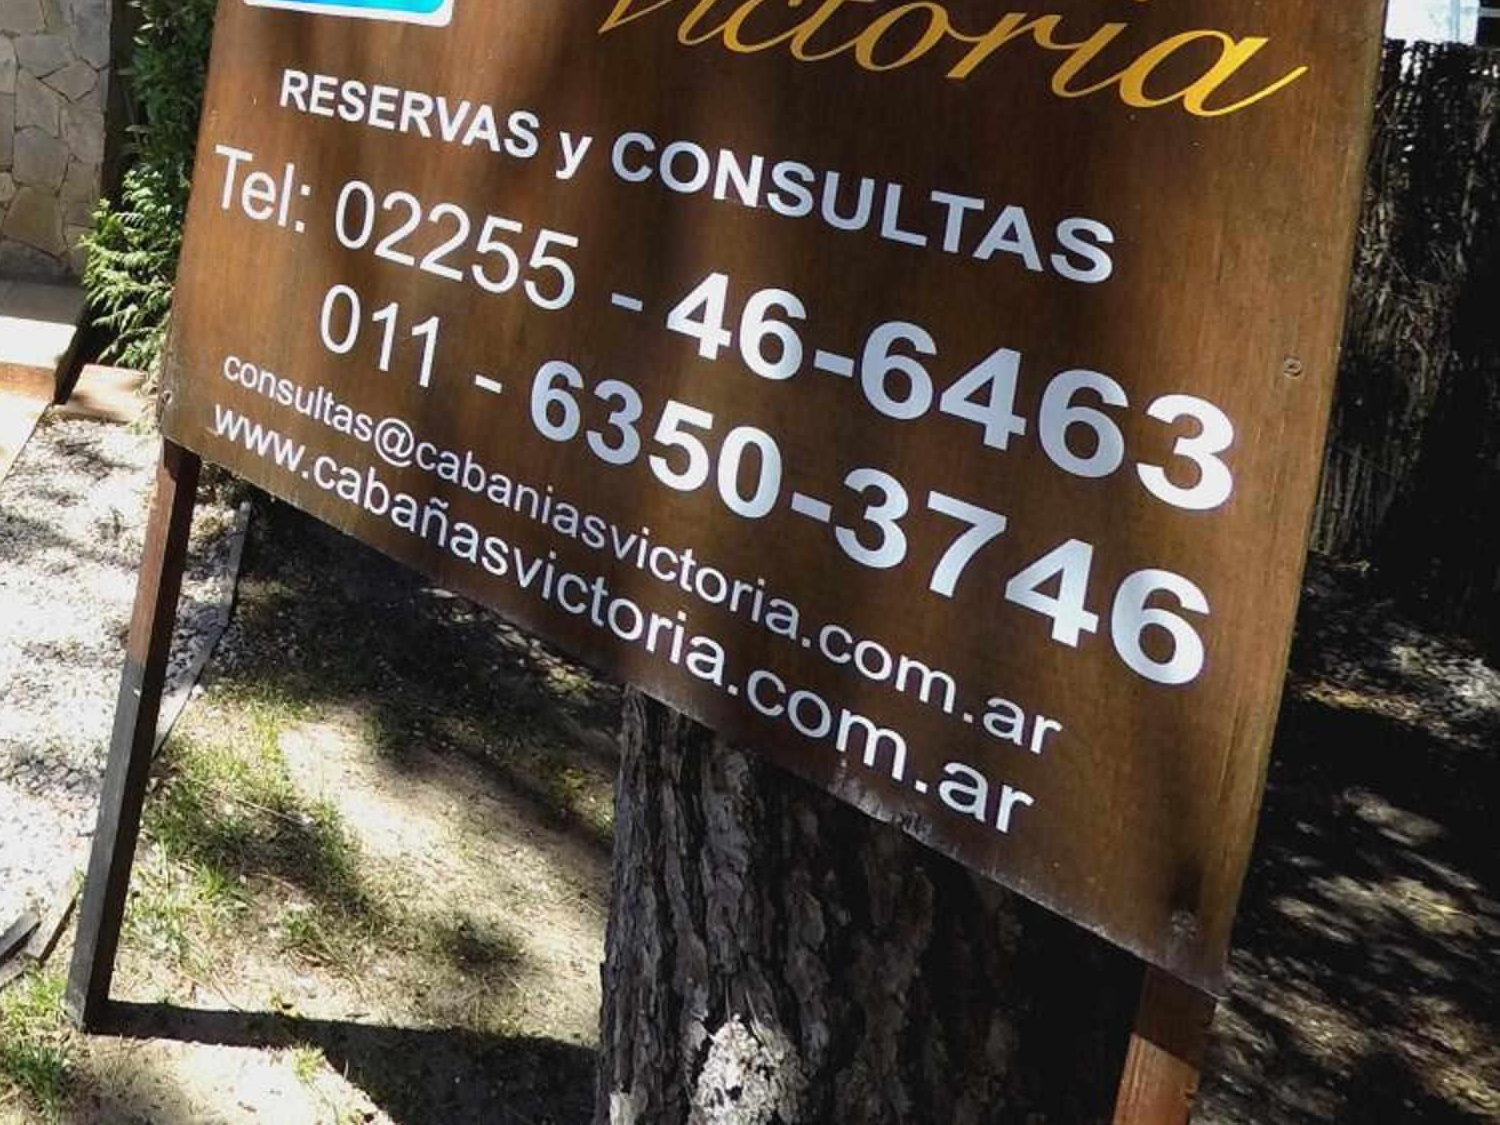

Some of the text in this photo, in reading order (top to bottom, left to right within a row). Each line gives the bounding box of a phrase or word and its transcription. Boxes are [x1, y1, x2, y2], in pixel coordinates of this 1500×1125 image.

[215, 145, 1235, 511] Tel: 02255 - 46-6463
[279, 69, 1115, 284] RESERVAS y CONSULTAS
[213, 404, 1035, 834] www.cabañasvictoria.com.ar
[223, 355, 1064, 756] consultas@cabaniasvictoria.com.ar
[319, 284, 1211, 686] 011 - 6350-3746
